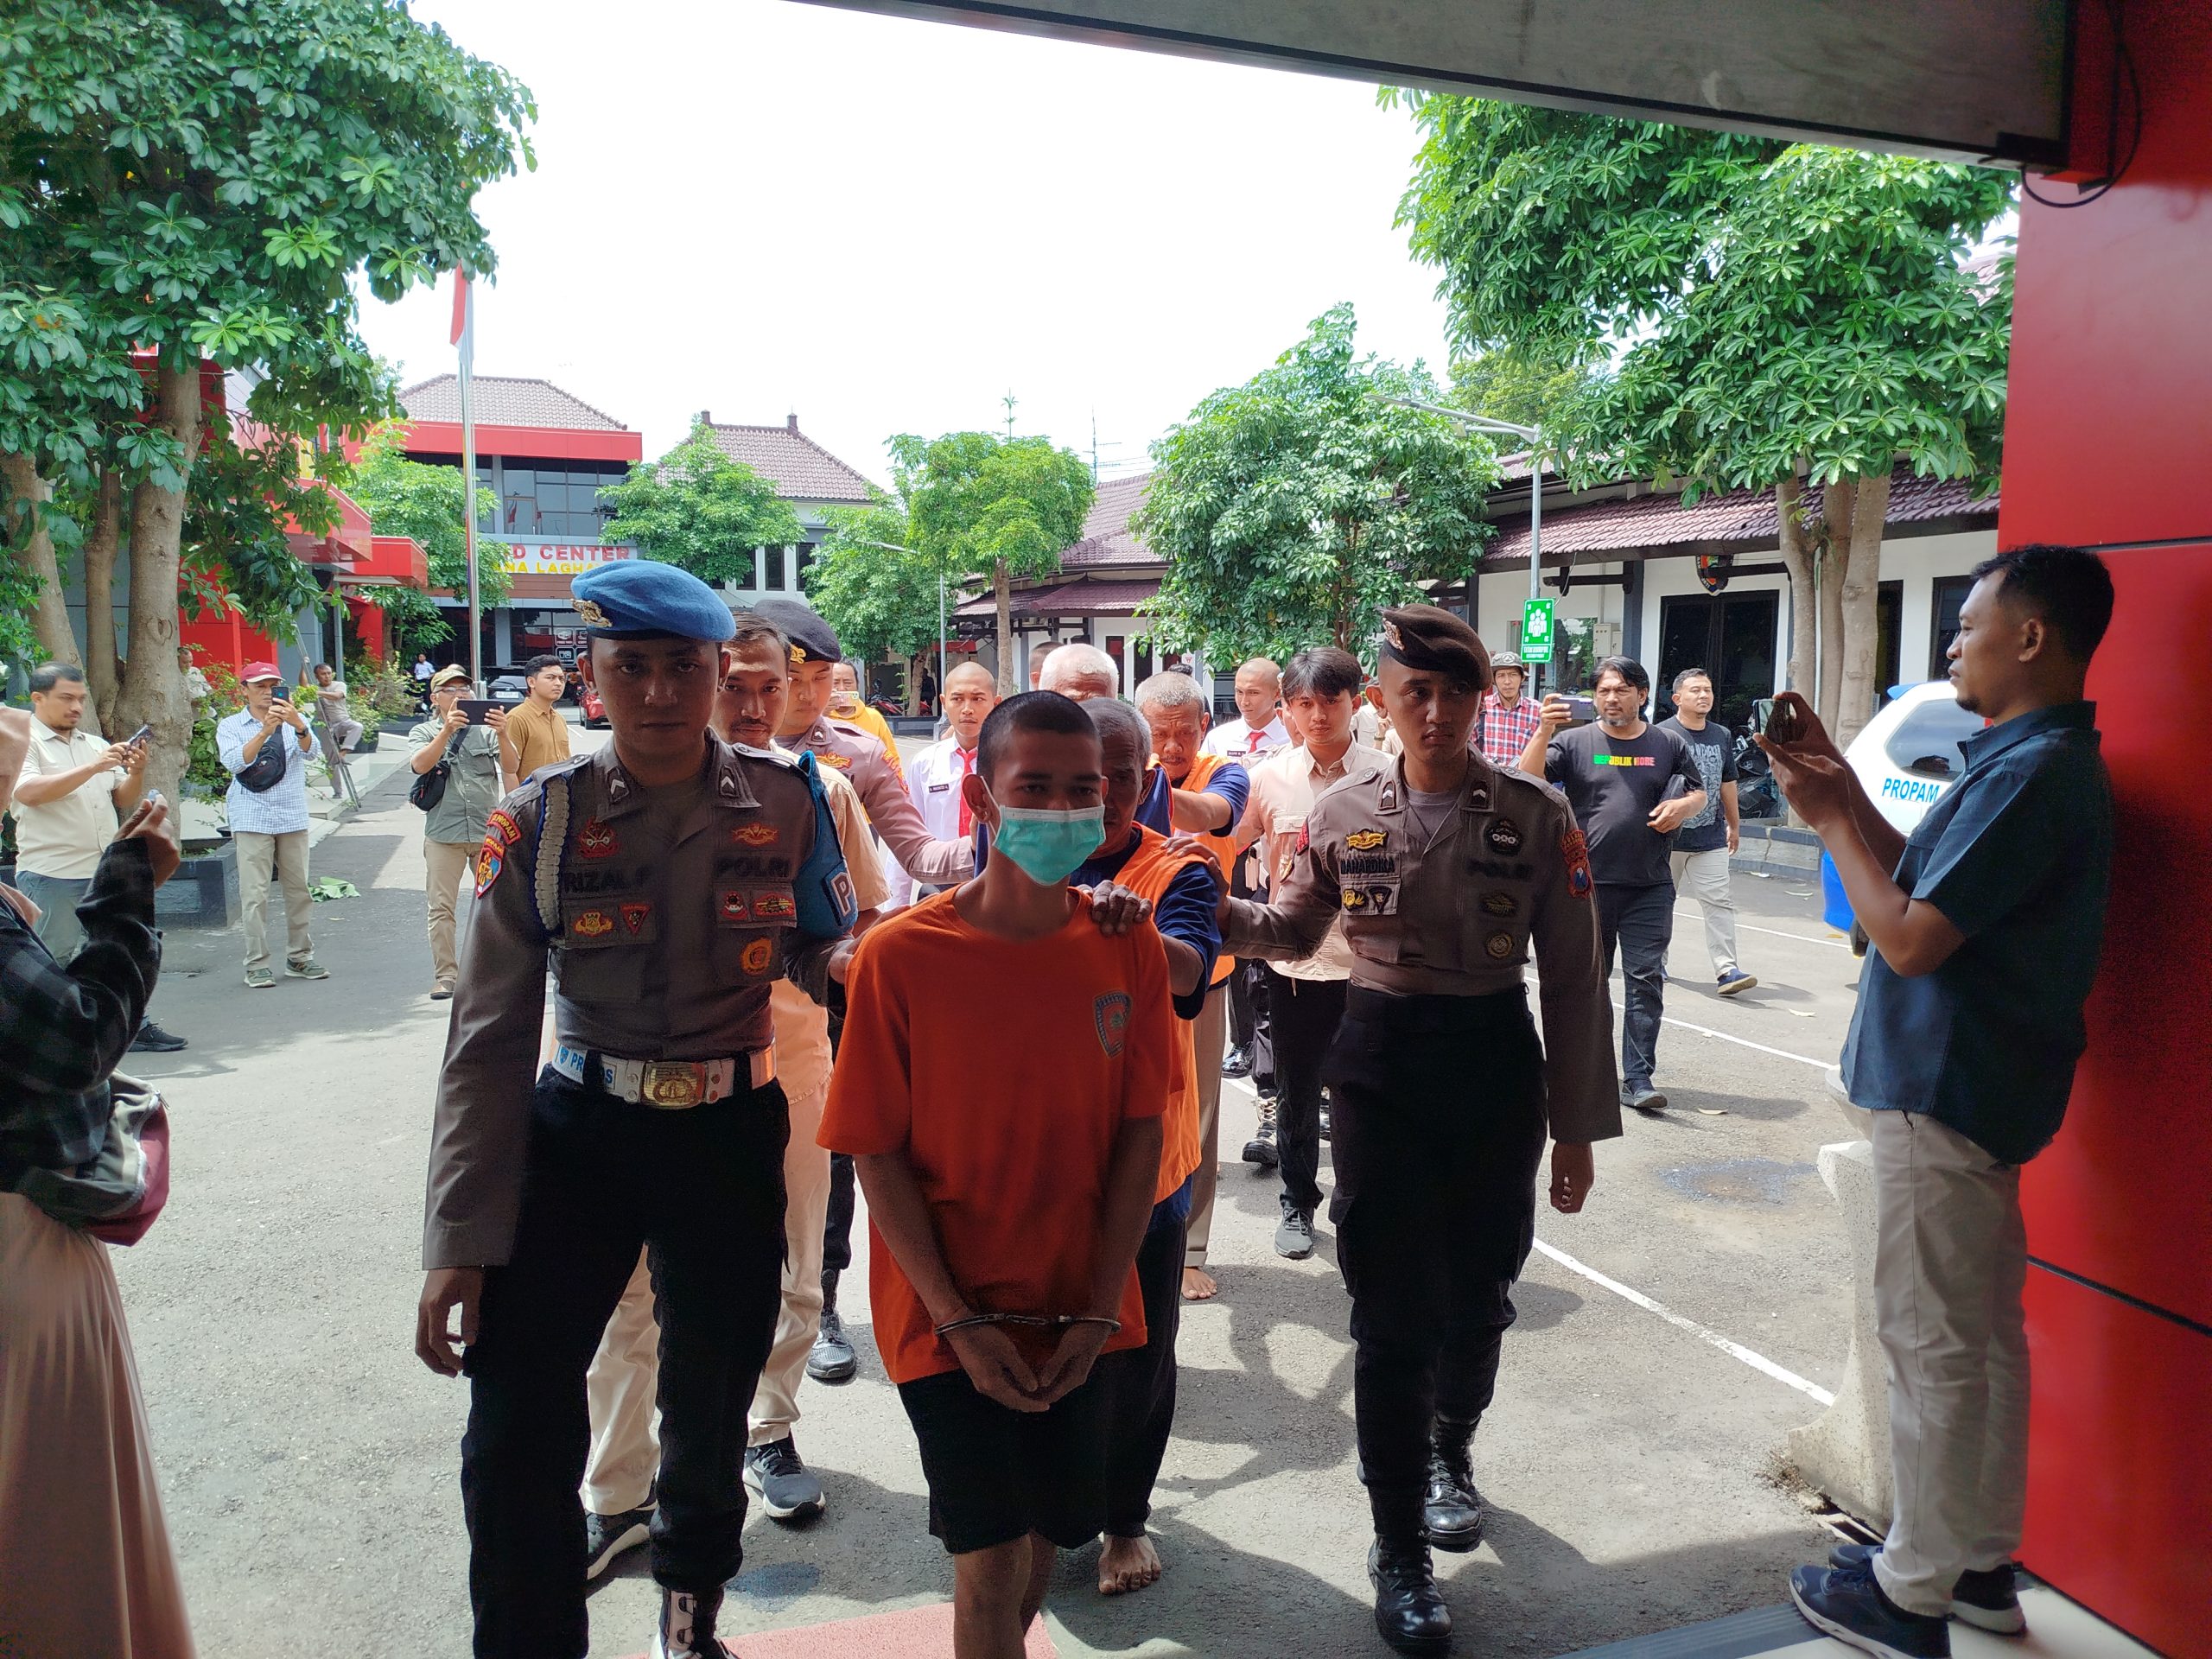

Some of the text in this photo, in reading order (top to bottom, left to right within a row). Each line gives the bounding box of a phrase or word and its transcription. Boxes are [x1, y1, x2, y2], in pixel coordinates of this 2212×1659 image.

[539, 544, 630, 561] CENTER
[1882, 778, 1940, 803] PROPAM
[830, 872, 852, 917] P
